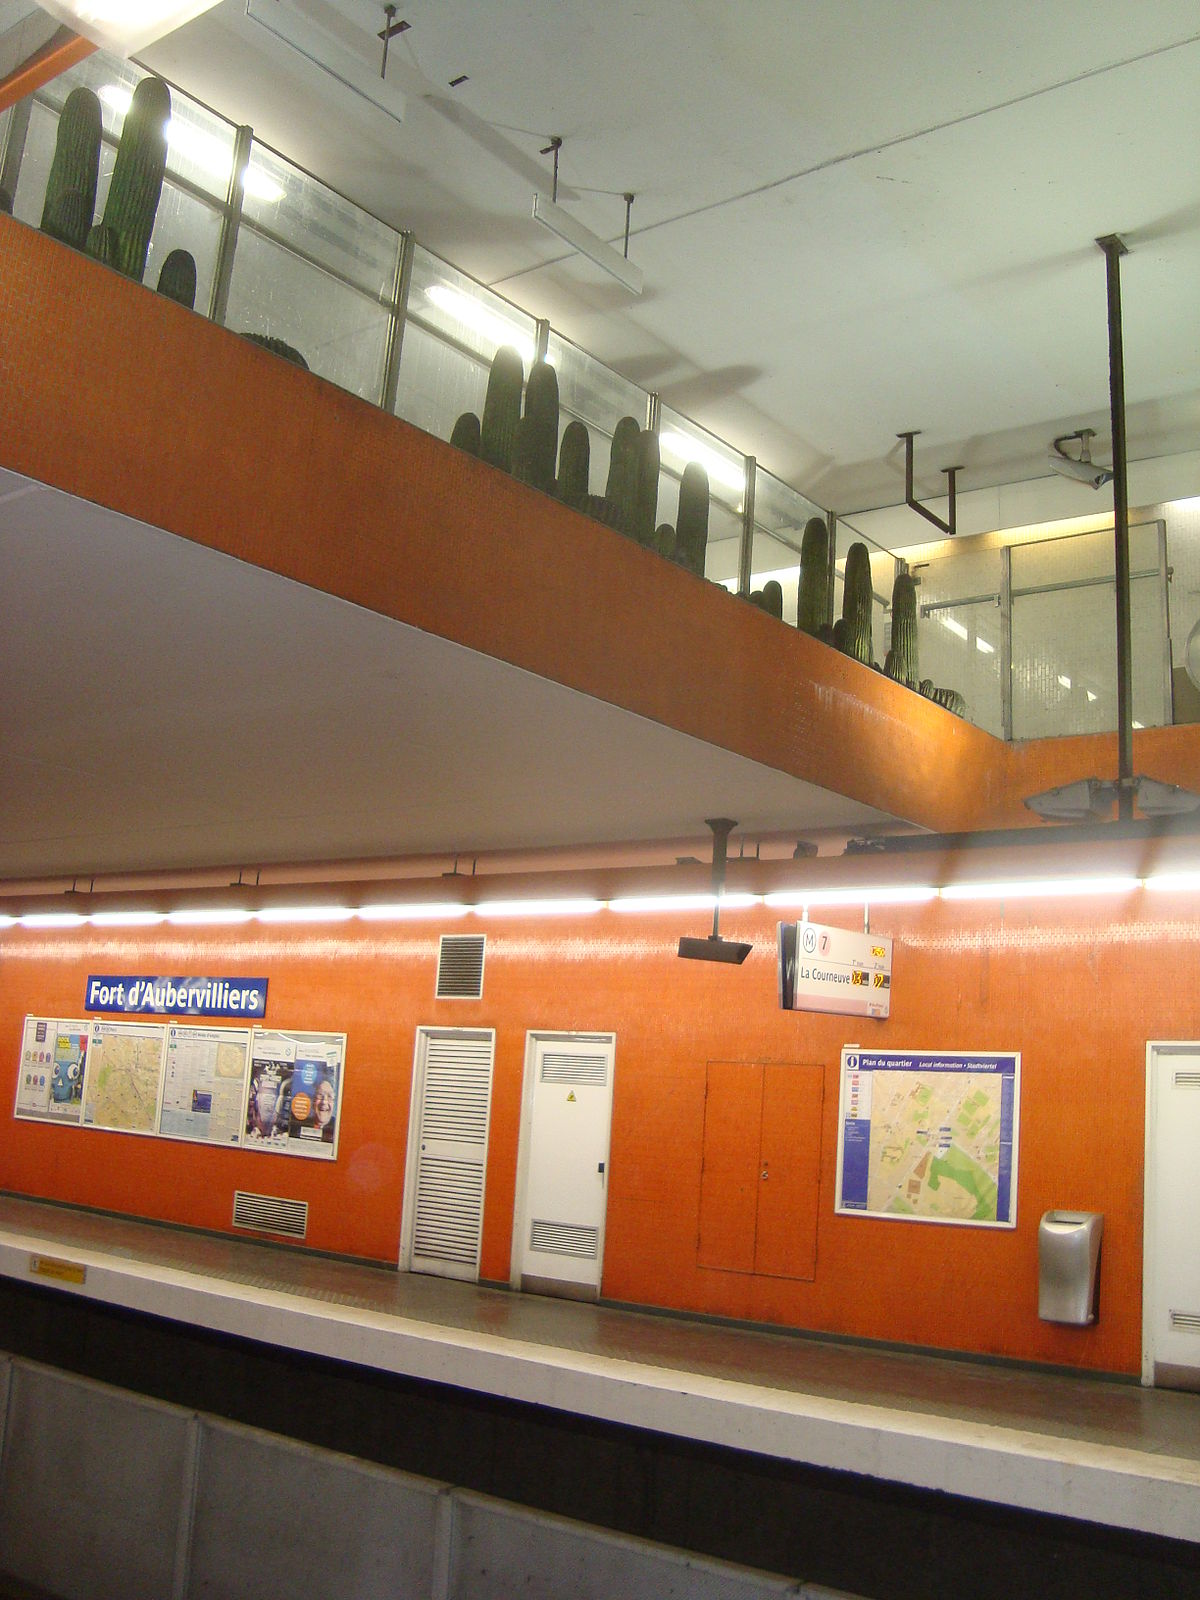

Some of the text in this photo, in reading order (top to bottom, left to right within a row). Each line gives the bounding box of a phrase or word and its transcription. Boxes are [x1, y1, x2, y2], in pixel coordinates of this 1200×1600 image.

[821, 935, 828, 951] 7
[800, 965, 851, 985] La Courneuve
[89, 980, 259, 1011] Fort d'Aubervilliers
[862, 1058, 913, 1068] Plan du quartier
[932, 1061, 963, 1069] information
